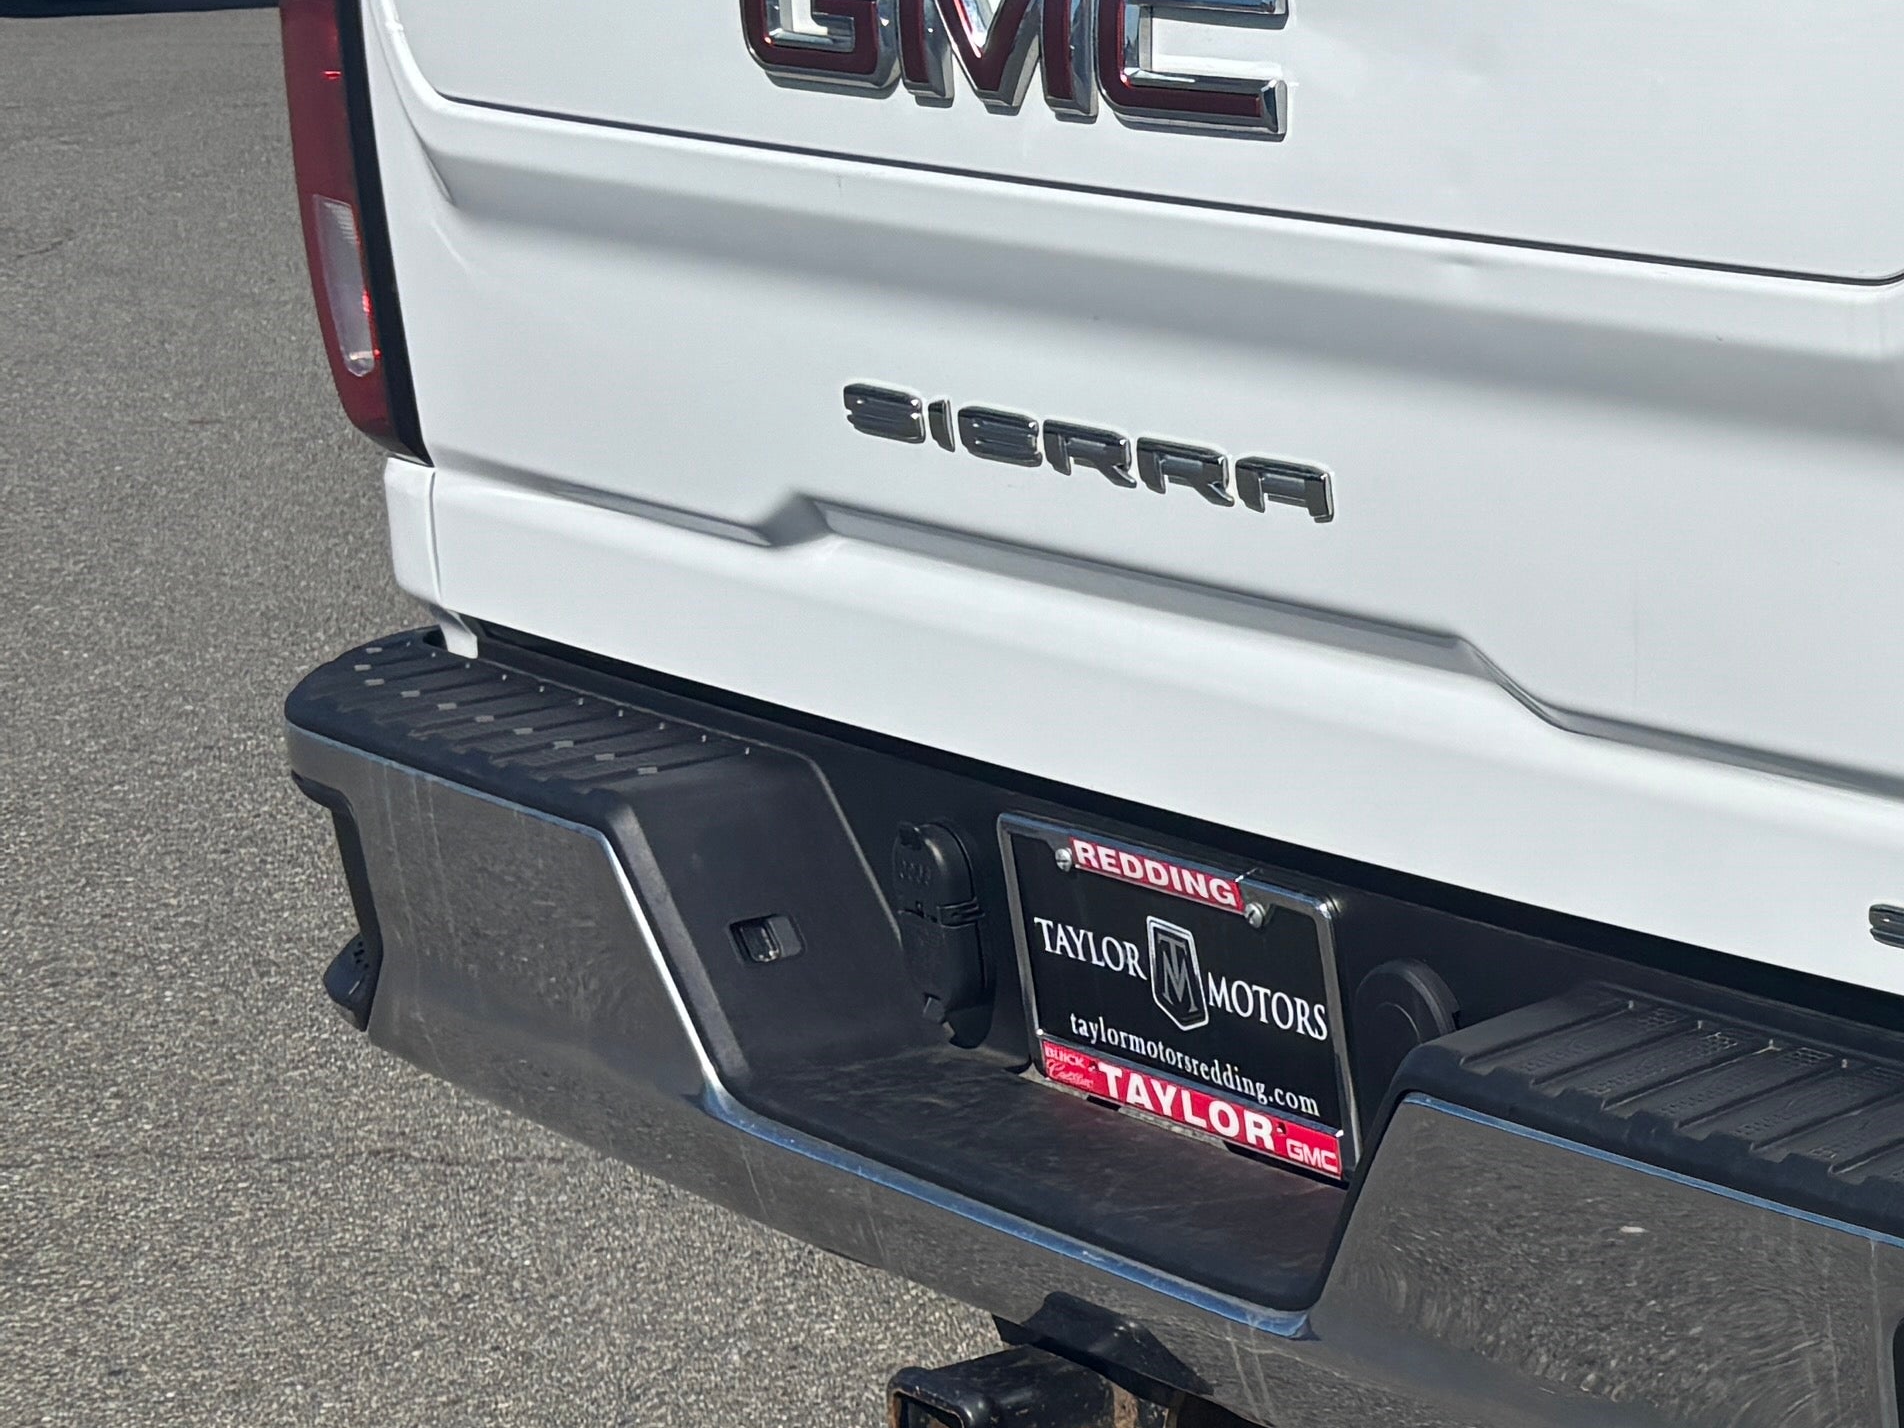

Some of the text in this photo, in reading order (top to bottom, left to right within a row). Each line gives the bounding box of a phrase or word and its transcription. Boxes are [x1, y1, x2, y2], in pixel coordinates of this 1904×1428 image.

[843, 382, 1335, 524] SIERRA
[1071, 838, 1238, 908] REDDING
[1034, 917, 1148, 981] TAYLOR
[1207, 972, 1328, 1041] MOTORS
[1069, 1013, 1321, 1117] taylormotorsredding.com
[1098, 1062, 1275, 1151] TAYLOR
[1285, 1138, 1338, 1172] GMC
